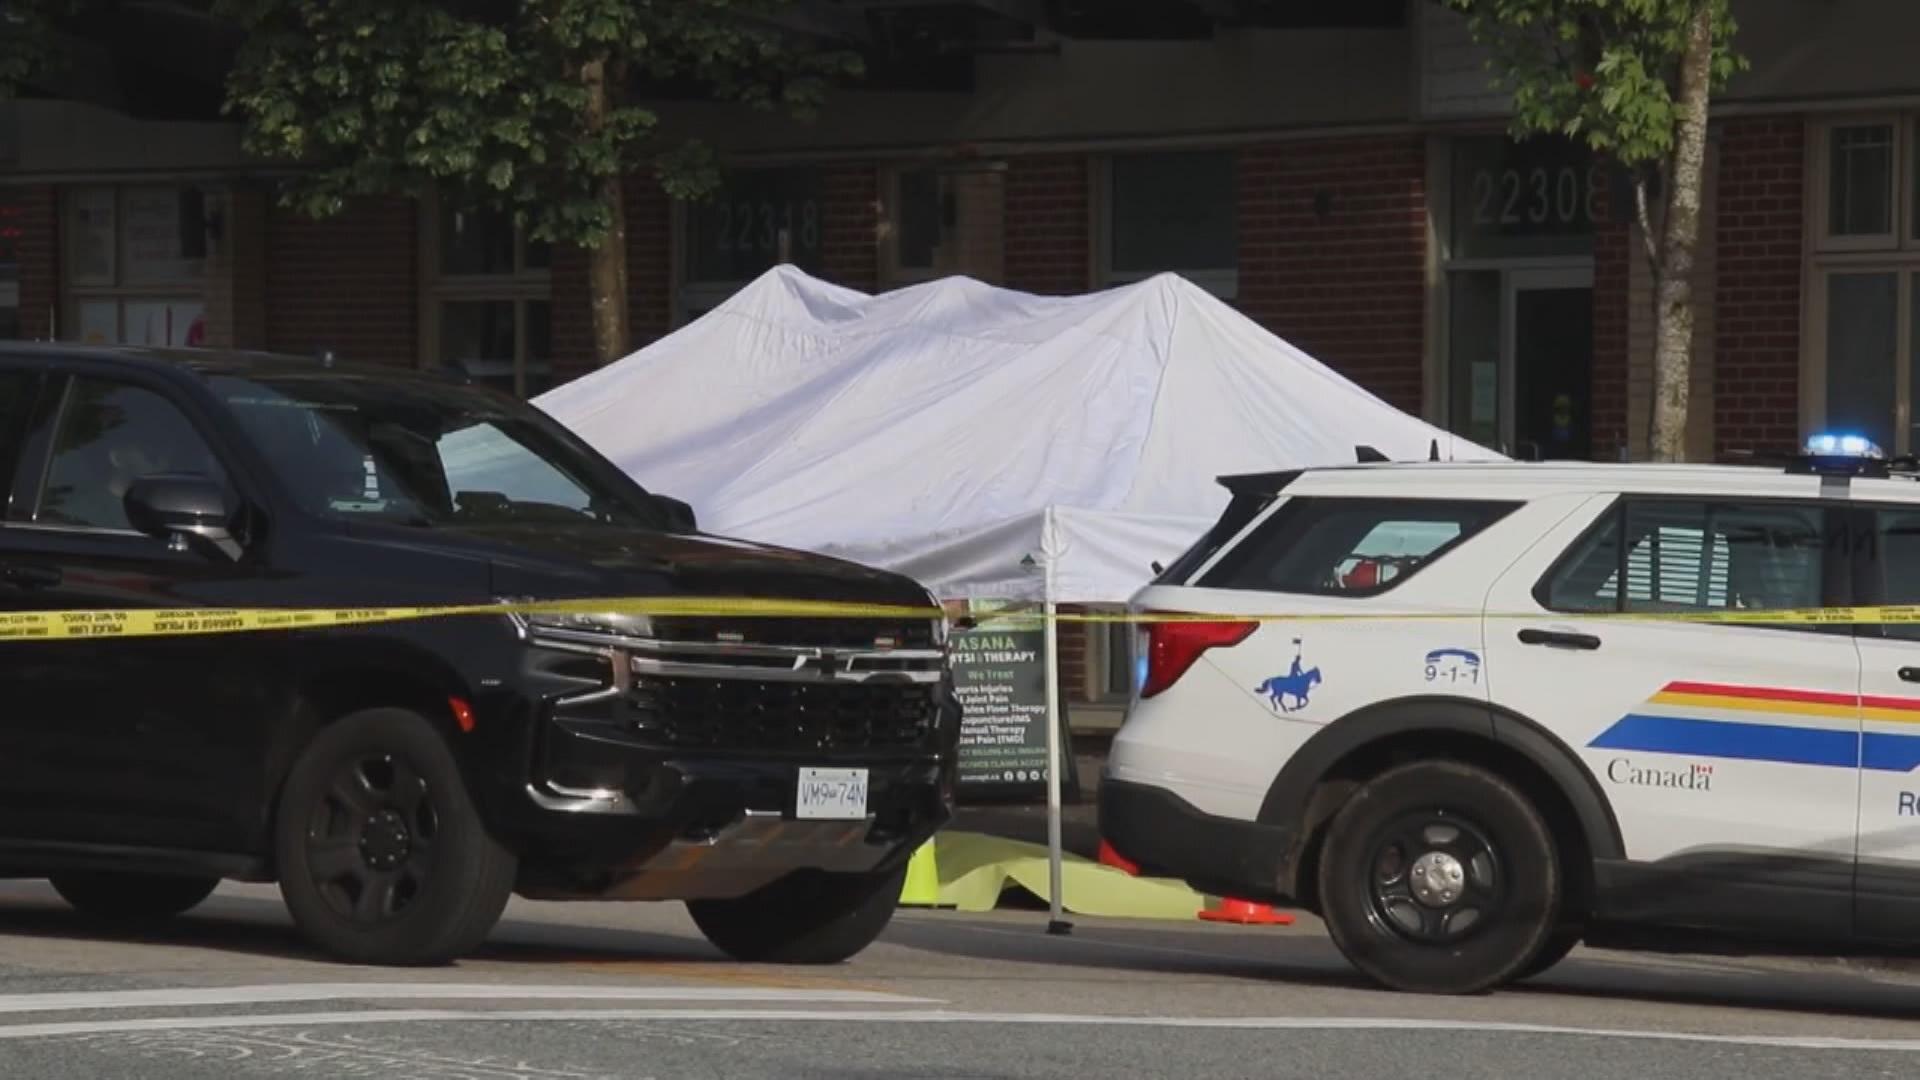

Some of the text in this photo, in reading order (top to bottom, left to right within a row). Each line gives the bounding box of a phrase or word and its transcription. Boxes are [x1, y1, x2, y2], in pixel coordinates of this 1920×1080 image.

[959, 636, 1016, 650] ASANA
[1424, 664, 1480, 684] 9-1-1
[1607, 757, 1713, 791] Canada
